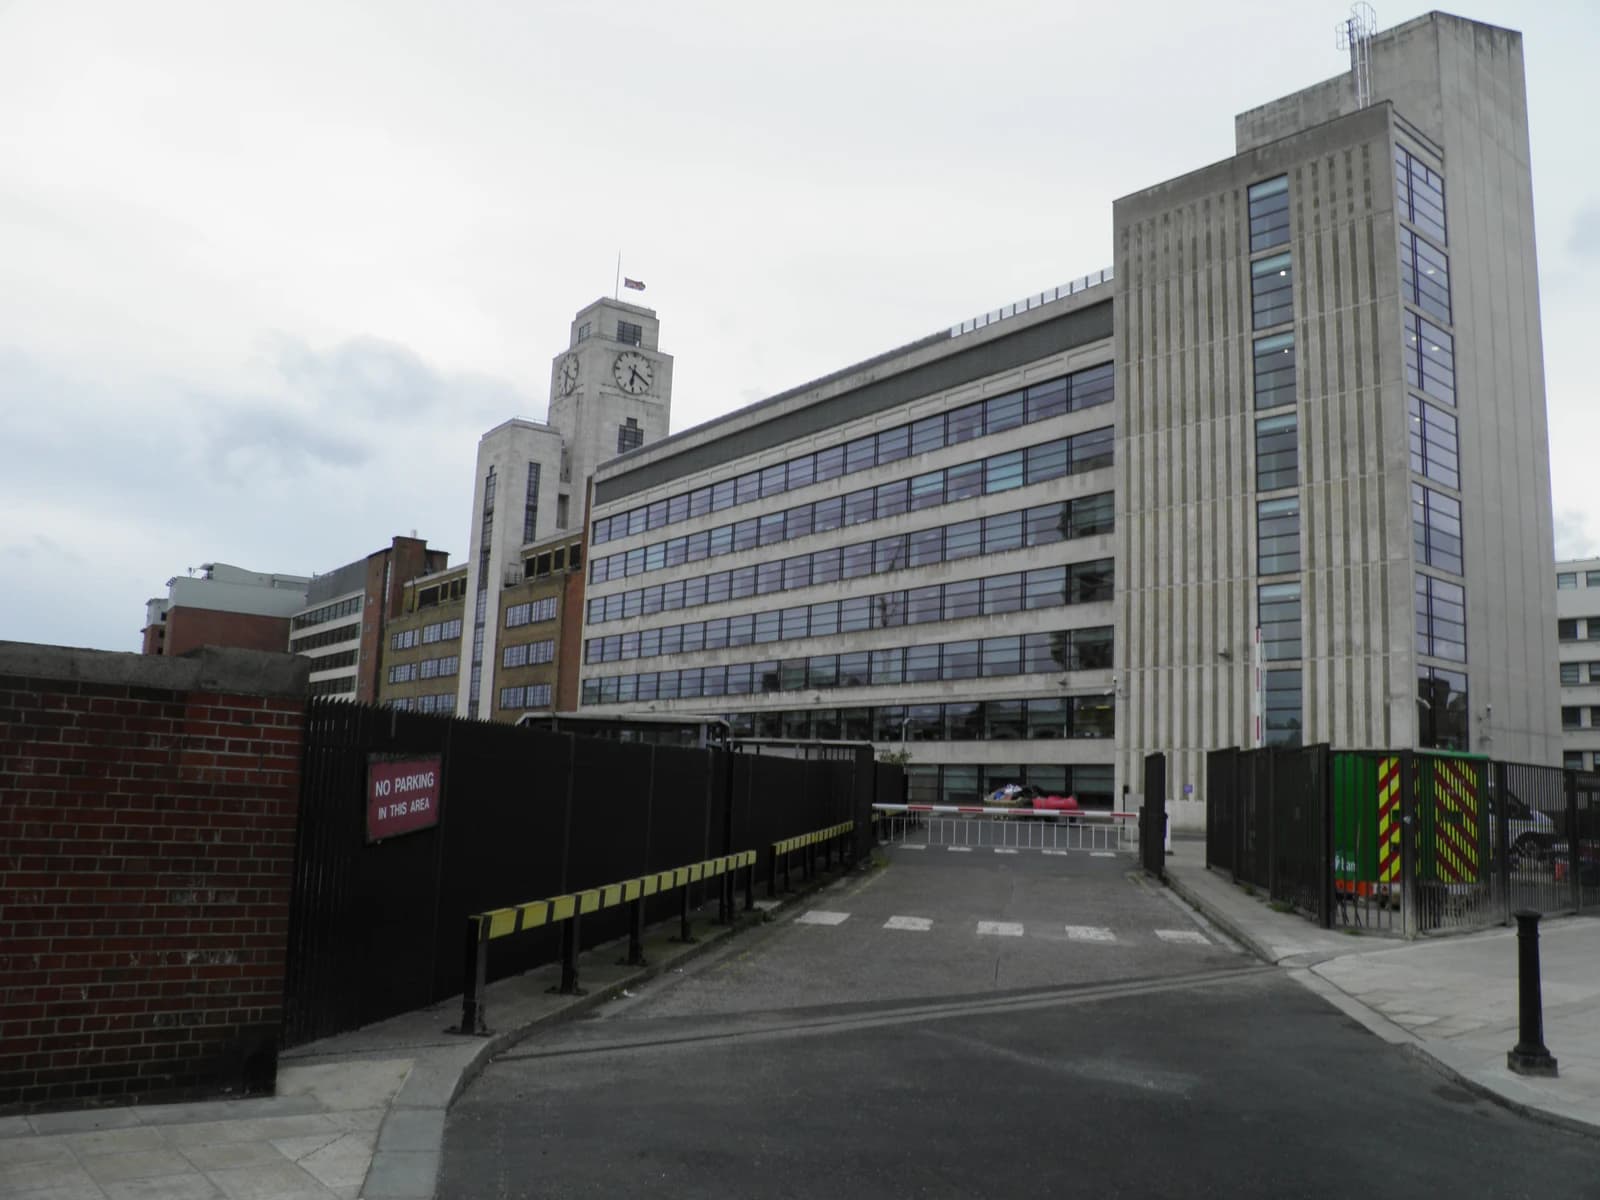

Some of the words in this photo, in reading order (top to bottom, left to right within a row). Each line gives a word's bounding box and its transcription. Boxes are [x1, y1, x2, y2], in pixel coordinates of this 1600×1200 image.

[375, 780, 391, 797] NO
[394, 771, 434, 793] PARKING
[378, 806, 387, 820] IN
[390, 801, 407, 816] THIS
[410, 797, 430, 813] AREA
